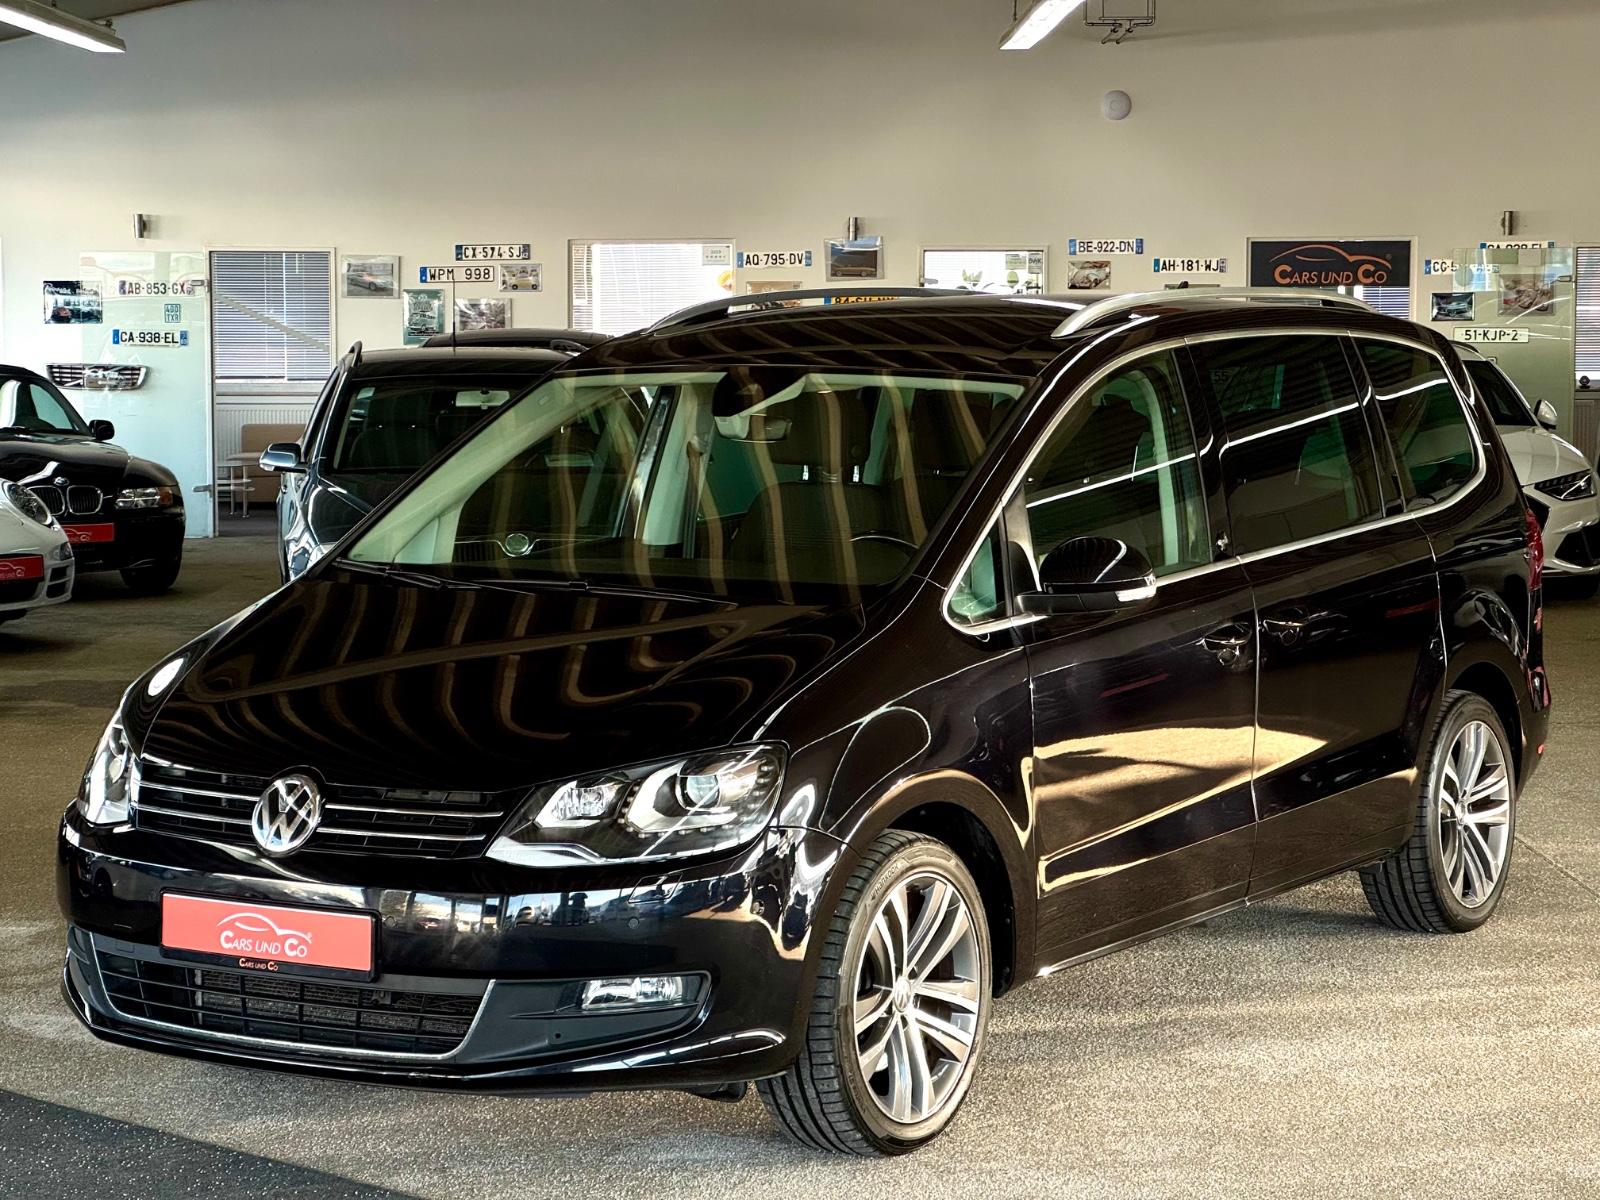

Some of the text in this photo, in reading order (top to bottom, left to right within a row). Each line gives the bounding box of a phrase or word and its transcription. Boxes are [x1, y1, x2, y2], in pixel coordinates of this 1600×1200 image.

[463, 246, 522, 259] CX-574-SJ
[1078, 241, 1134, 252] BE-922-DN
[745, 253, 803, 266] AQ-795-DV
[1160, 259, 1219, 272] AH-181-WJ
[429, 267, 491, 281] WPM 998
[127, 282, 186, 295] AB-853-GX
[120, 331, 179, 344] CA-938-EL
[1464, 329, 1518, 341] 51-KJP-2
[255, 941, 281, 955] UND
